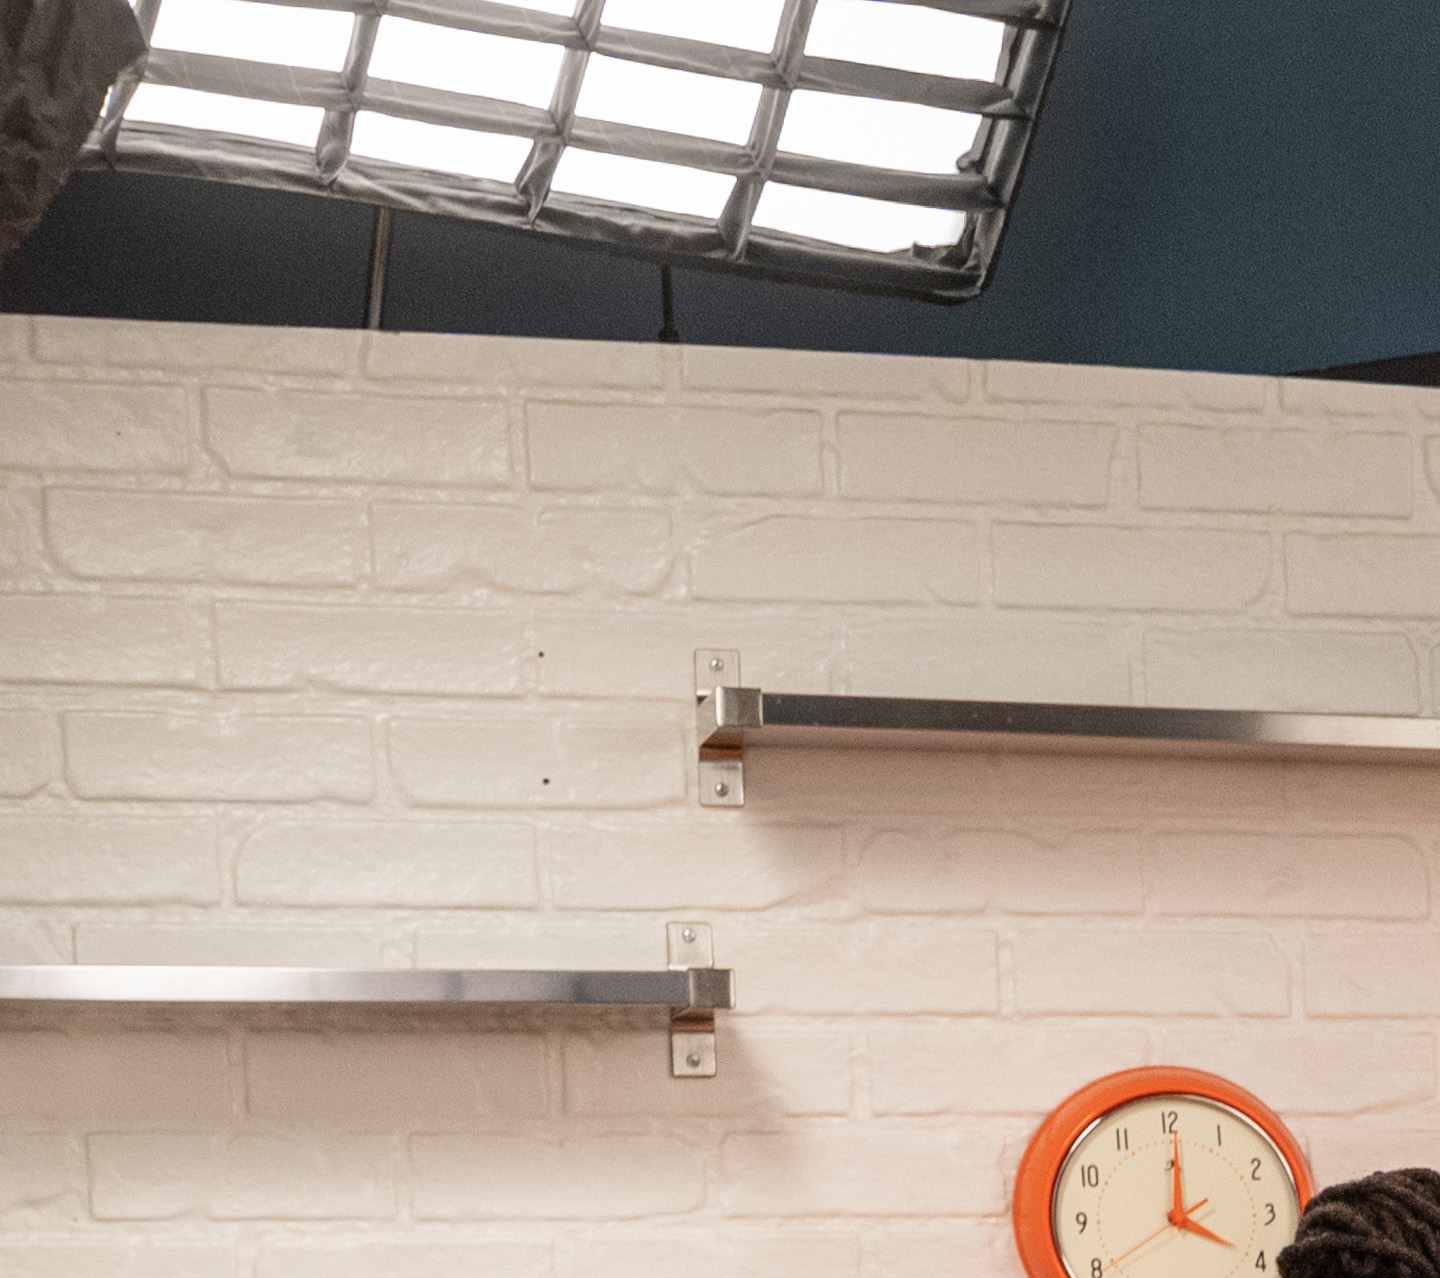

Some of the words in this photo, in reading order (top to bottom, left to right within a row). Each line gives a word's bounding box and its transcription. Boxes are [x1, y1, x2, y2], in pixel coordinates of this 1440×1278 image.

[1161, 1111, 1178, 1134] 12
[1115, 1128, 1129, 1150] 11
[1216, 1124, 1222, 1147] 1
[1081, 1165, 1099, 1188] 10
[1250, 1158, 1262, 1181] 2
[1075, 1212, 1088, 1234] 9
[1264, 1203, 1276, 1226] 3
[1254, 1250, 1266, 1272] 4
